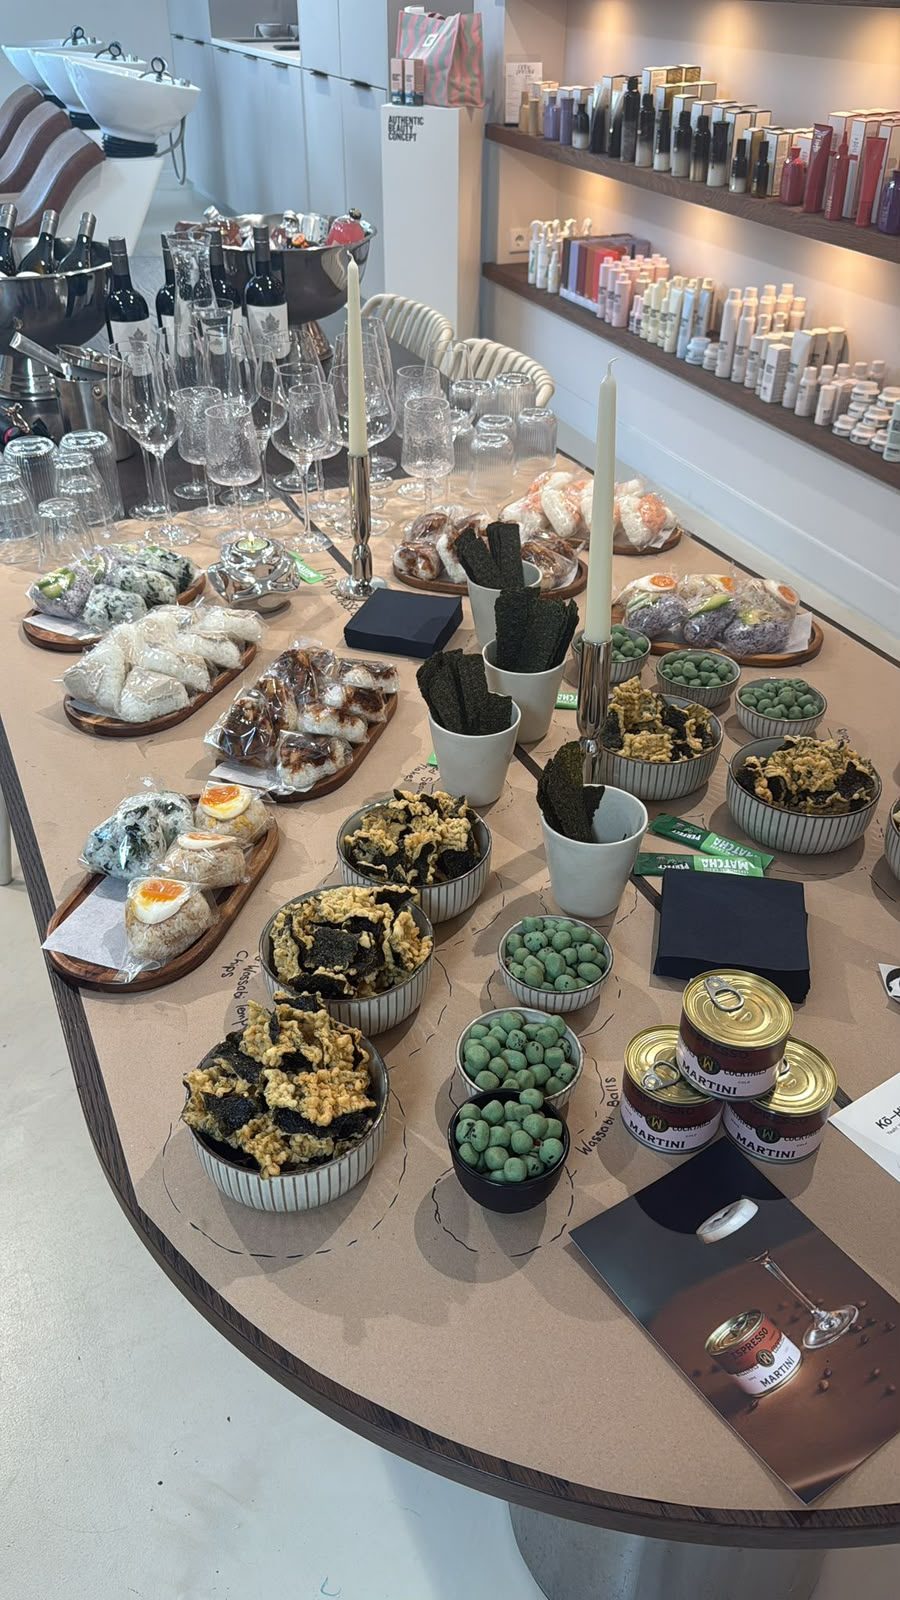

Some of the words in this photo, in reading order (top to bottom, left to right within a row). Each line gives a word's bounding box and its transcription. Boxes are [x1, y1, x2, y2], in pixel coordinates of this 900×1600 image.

[388, 115, 424, 126] AUTHENTIC
[388, 124, 413, 134] BEAUTY
[388, 132, 416, 142] CONCEPT
[701, 858, 749, 870] MATCHA
[221, 950, 248, 978] Chips
[681, 1060, 738, 1095] MARTINI
[575, 1116, 615, 1156] Wassabi
[605, 1077, 620, 1108] Balls
[629, 1120, 686, 1149] MARTINI
[735, 1132, 797, 1159] MARTINI
[760, 1355, 795, 1388] MARTINI
